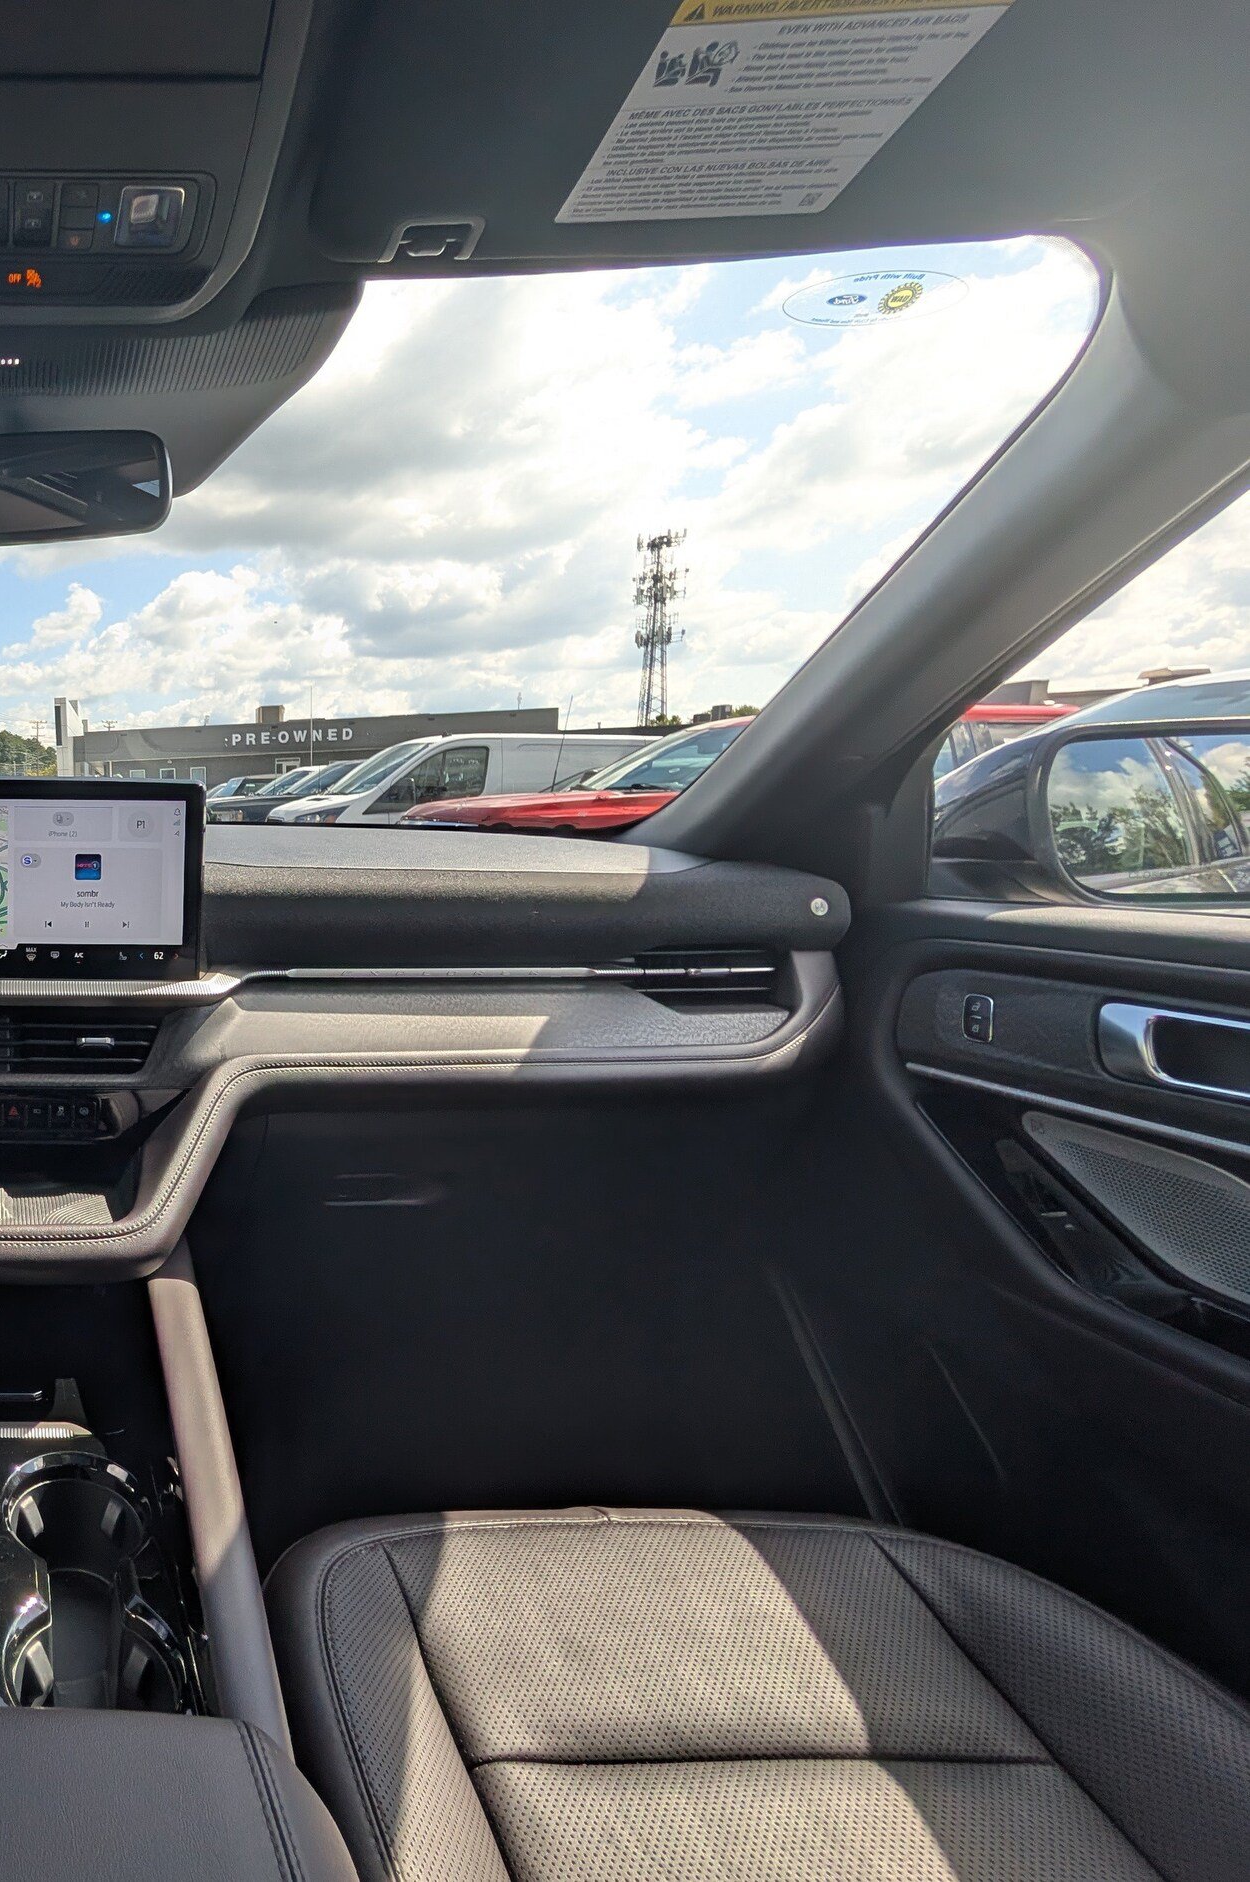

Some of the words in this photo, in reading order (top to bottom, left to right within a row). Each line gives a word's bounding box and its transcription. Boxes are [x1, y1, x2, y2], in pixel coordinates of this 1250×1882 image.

[713, 2, 776, 17] WARNING
[778, 22, 814, 35] EVEN
[813, 20, 848, 33] WITH
[845, 16, 911, 31] ADVANCED
[909, 14, 931, 26] AIR
[932, 12, 969, 25] BAGS
[661, 106, 694, 119] AVEC
[692, 105, 716, 117] DES
[715, 104, 747, 116] SACS
[747, 100, 821, 115] GONFLABLES
[606, 166, 661, 178] INCLUSIVE
[659, 164, 685, 176] CON
[684, 163, 706, 175] LAS
[705, 161, 749, 174] NUEVAS
[748, 158, 790, 172] BOLSAS
[788, 158, 806, 170] DE
[7, 272, 22, 284] OFF
[231, 727, 355, 747] PRE-OWNED
[136, 820, 146, 829] P1
[68, 830, 78, 838] (2)
[76, 889, 100, 898] sombr
[60, 901, 69, 909] My
[69, 901, 84, 909] Body
[83, 901, 97, 909] Isn't
[97, 901, 116, 909] Ready
[153, 951, 165, 960] 62
